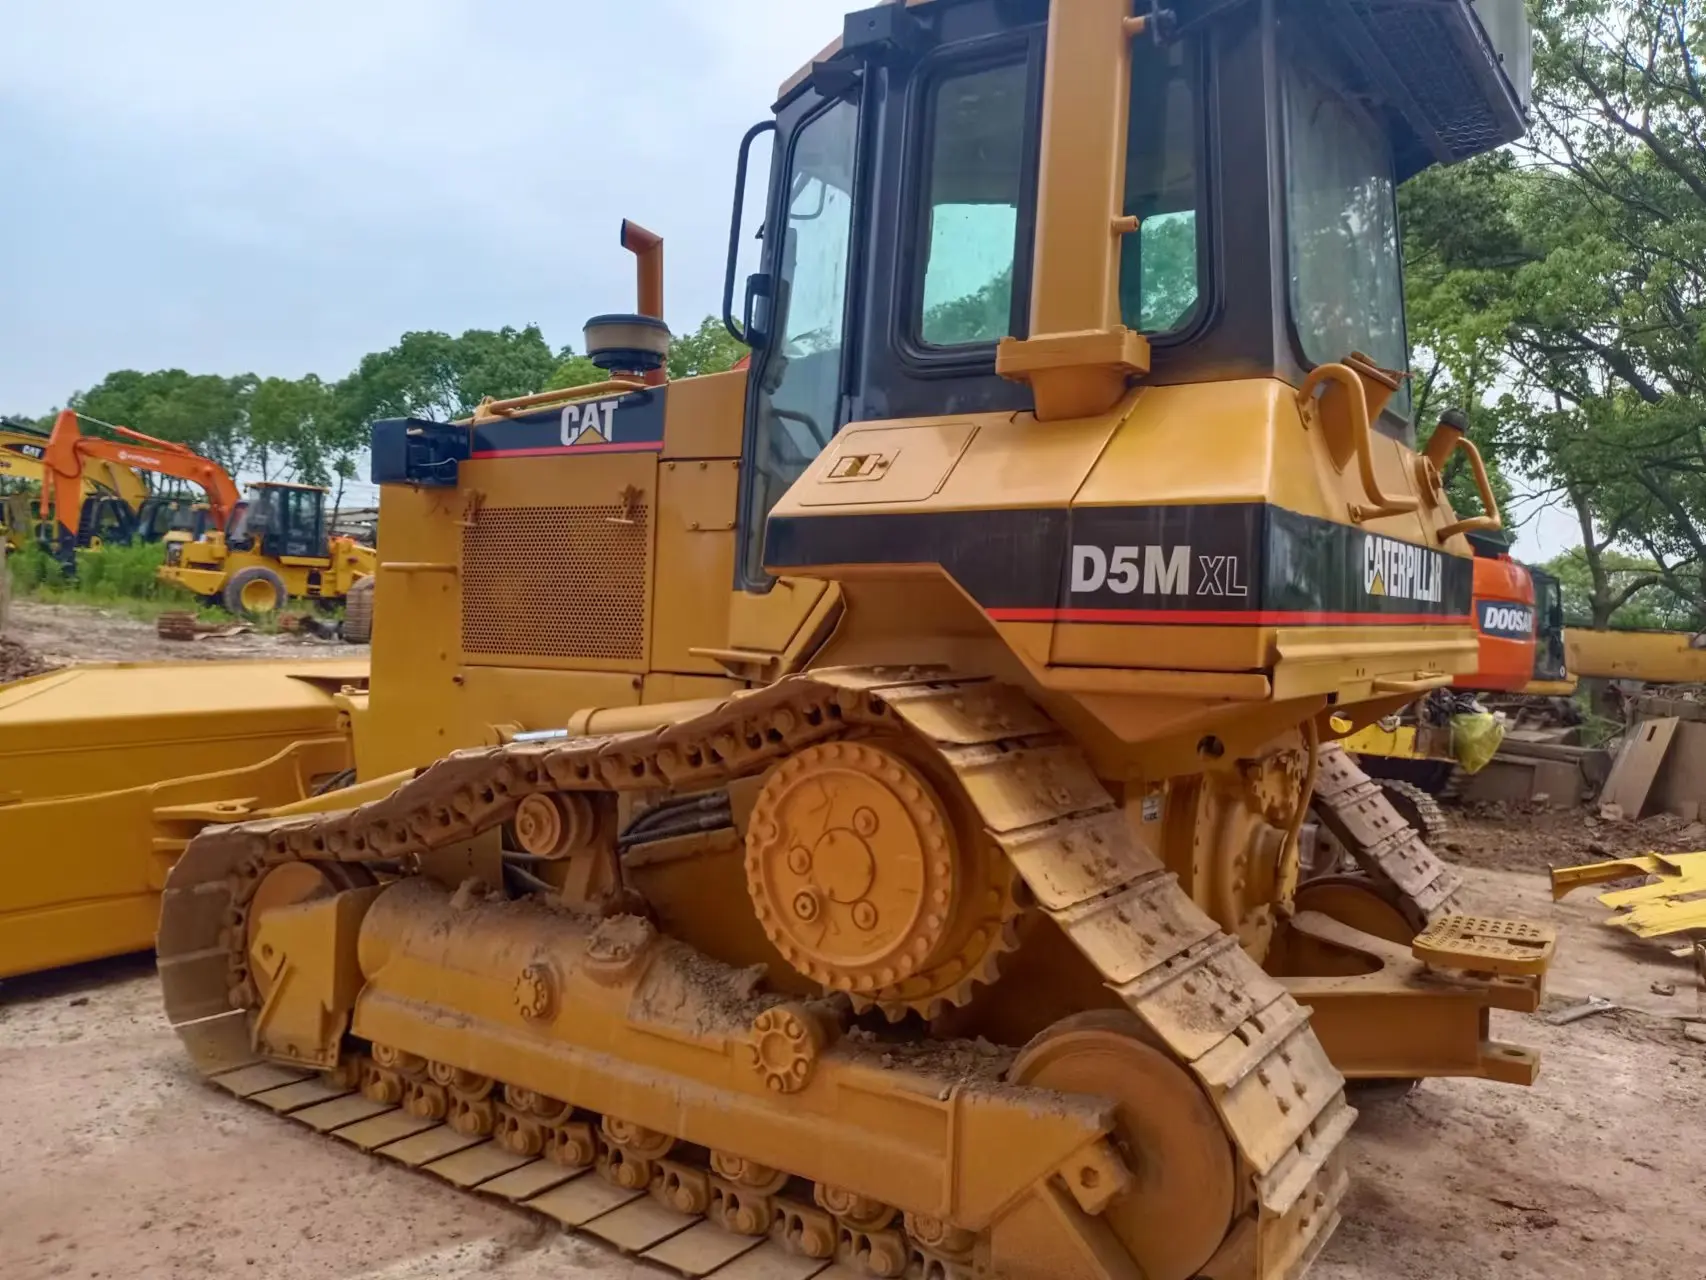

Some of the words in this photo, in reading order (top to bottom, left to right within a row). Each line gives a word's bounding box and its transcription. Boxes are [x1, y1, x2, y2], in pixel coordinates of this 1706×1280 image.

[560, 400, 619, 446] CAT
[1071, 545, 1191, 595] D5M
[1196, 556, 1248, 596] XL
[1364, 535, 1442, 602] CATERPILLAR
